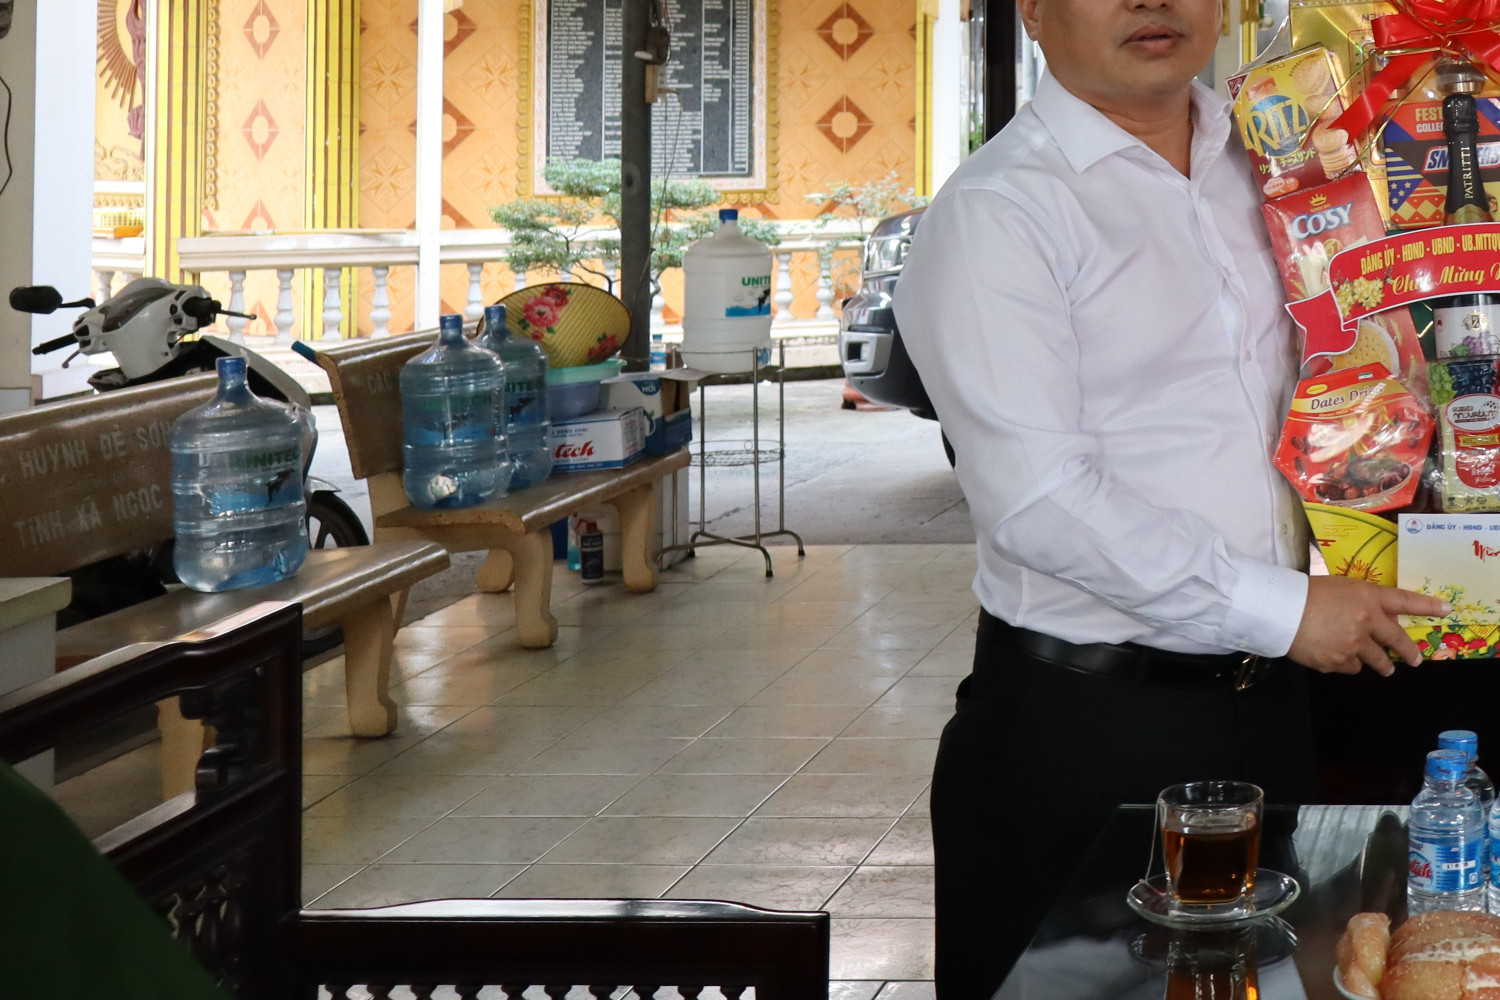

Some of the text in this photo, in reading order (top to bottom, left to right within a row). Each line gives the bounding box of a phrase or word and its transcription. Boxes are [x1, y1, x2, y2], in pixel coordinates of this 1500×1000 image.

[1247, 101, 1308, 157] RITZ
[1416, 107, 1443, 121] FEST
[1461, 147, 1474, 199] PATRITTI
[1291, 201, 1353, 239] COSY
[1360, 250, 1383, 275] ĐẢNG
[1384, 244, 1395, 267] ỦY
[1402, 241, 1425, 262] HĐND
[1431, 236, 1455, 256] UBND
[1435, 265, 1485, 285] Mừng
[1311, 396, 1345, 410] Dates
